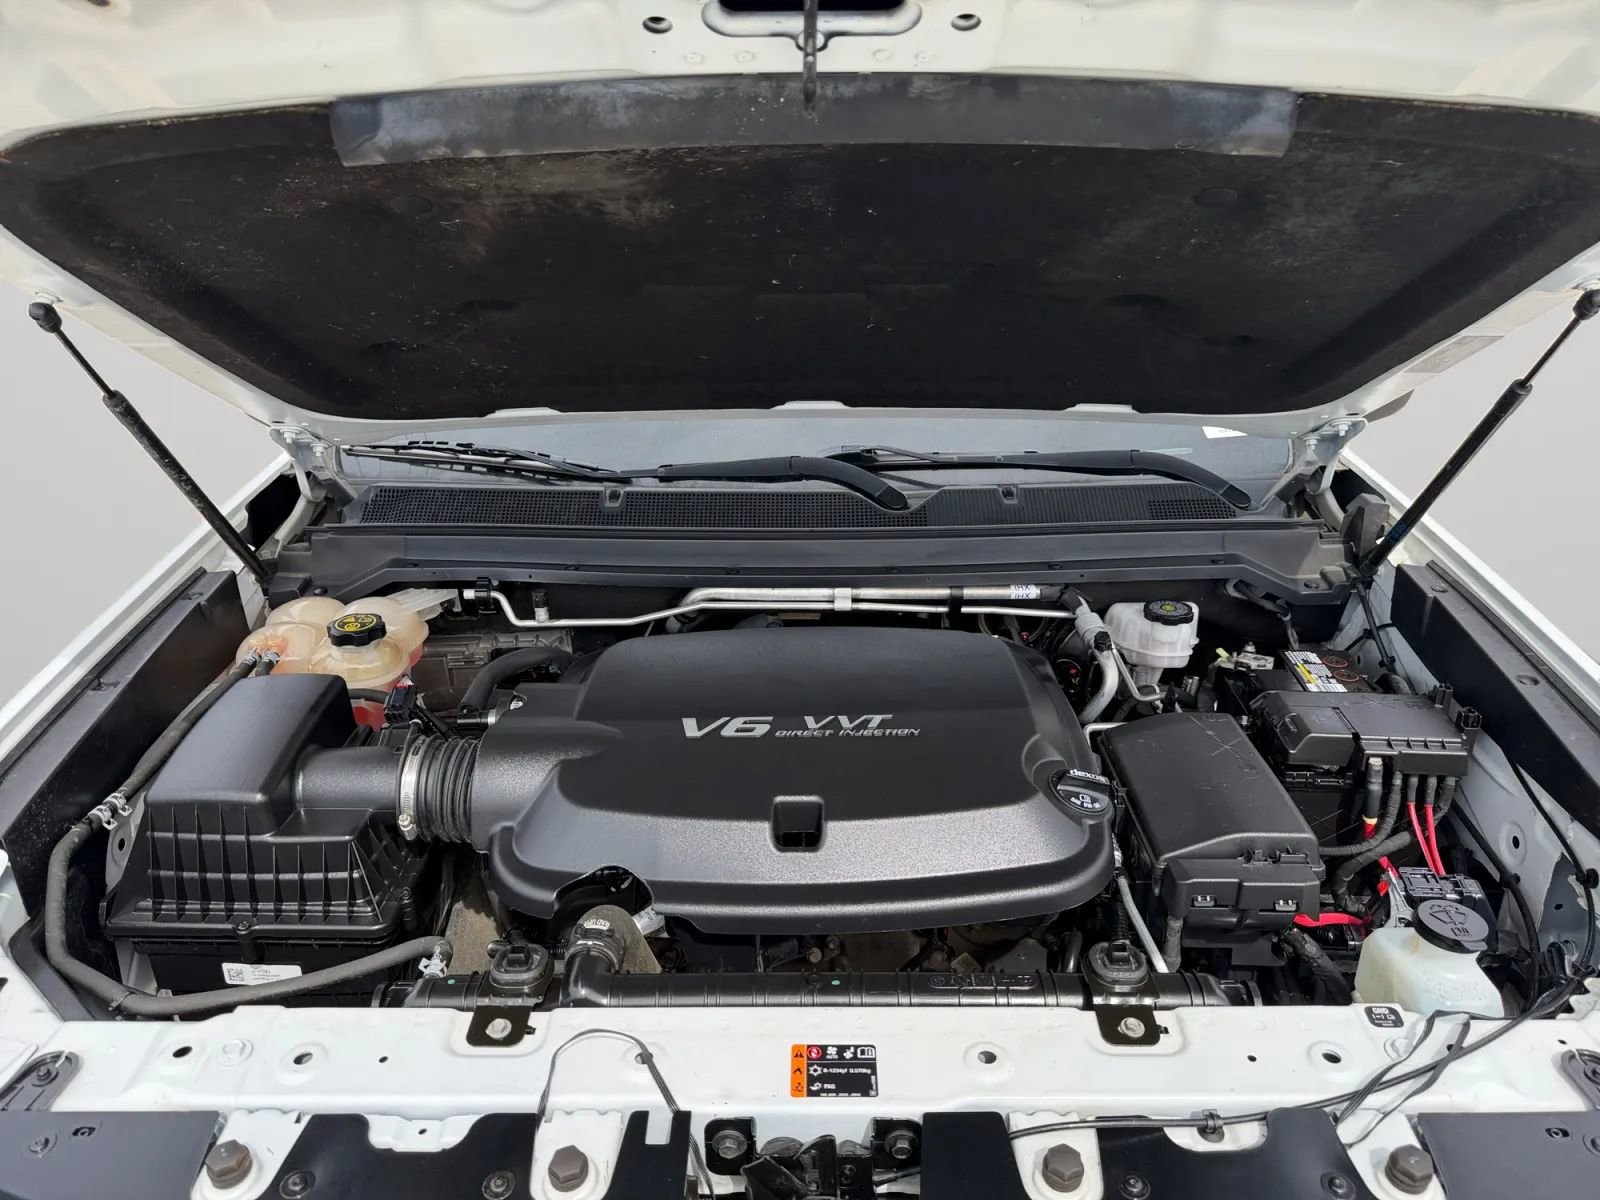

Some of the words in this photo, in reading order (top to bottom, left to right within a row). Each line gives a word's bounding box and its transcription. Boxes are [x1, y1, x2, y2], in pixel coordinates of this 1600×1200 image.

[682, 716, 774, 738] V6
[803, 714, 893, 729] VVT
[838, 728, 920, 737] INJECTION
